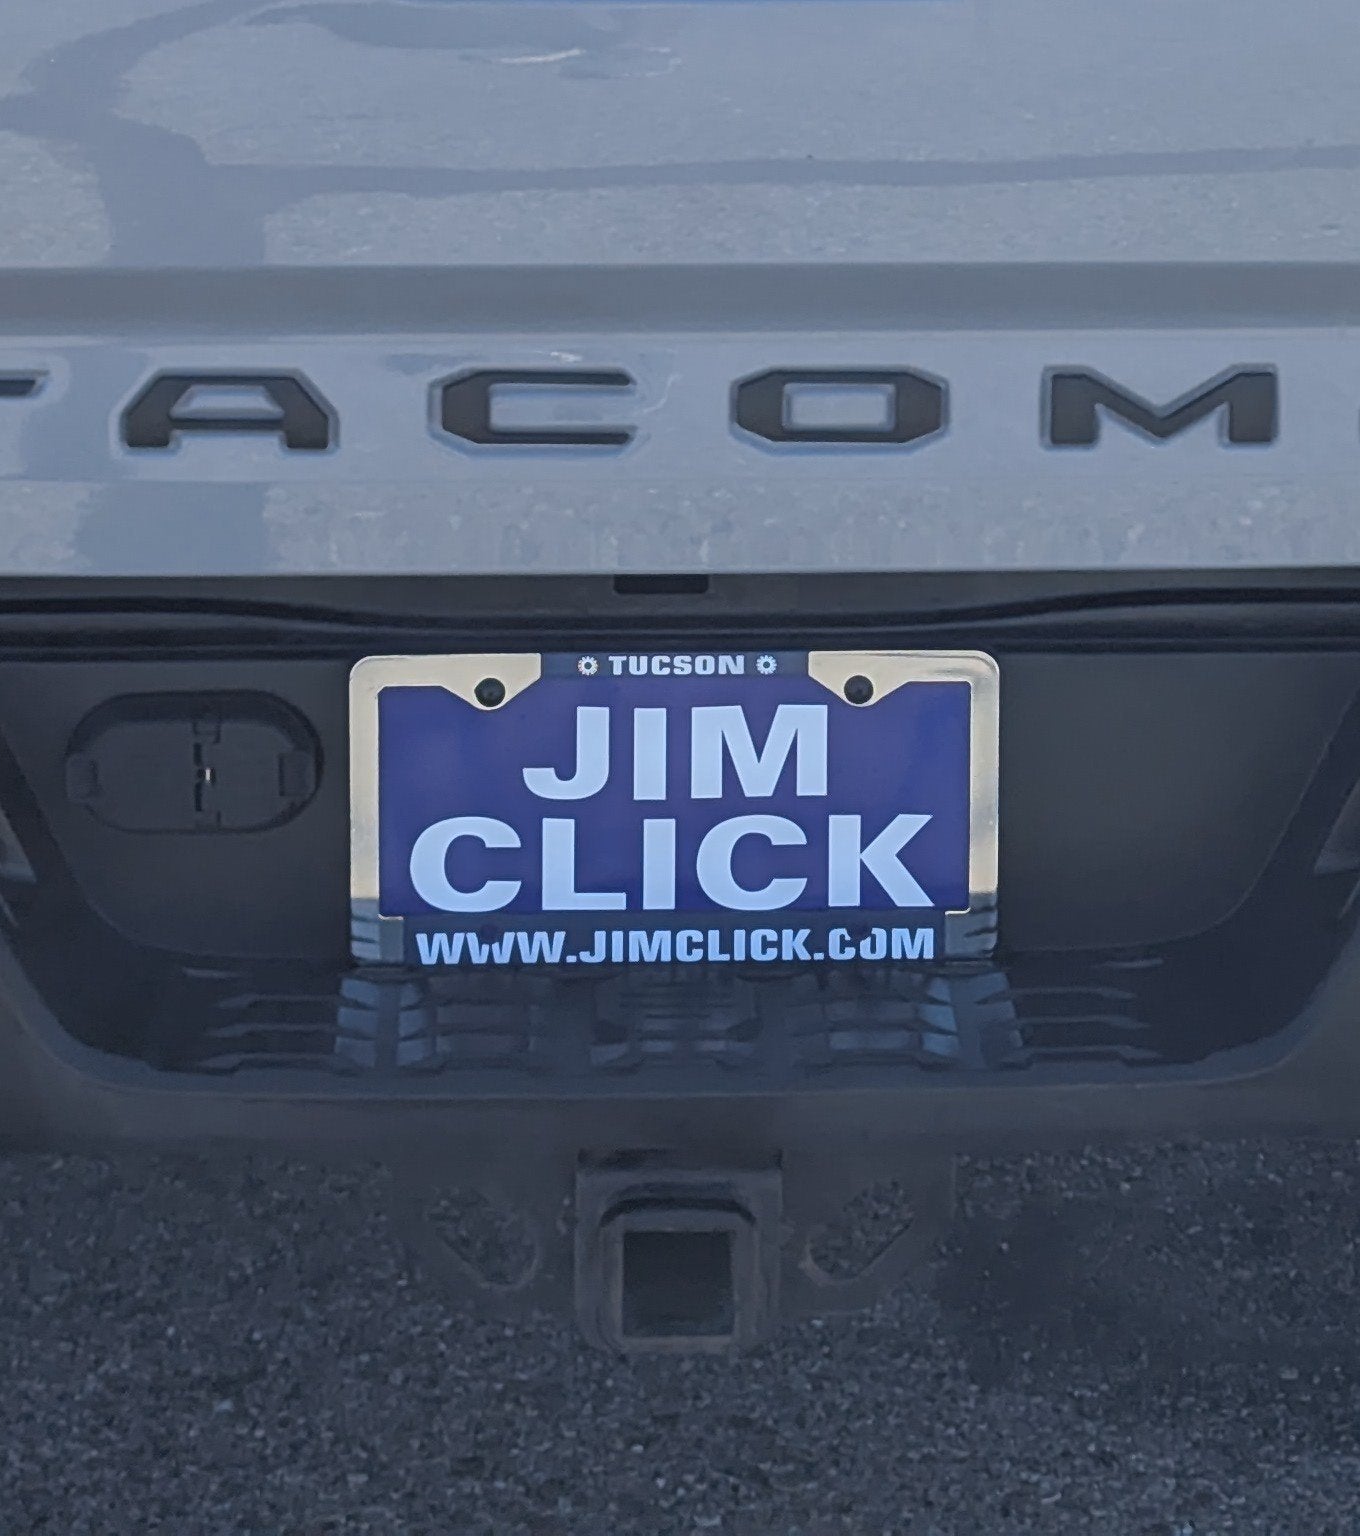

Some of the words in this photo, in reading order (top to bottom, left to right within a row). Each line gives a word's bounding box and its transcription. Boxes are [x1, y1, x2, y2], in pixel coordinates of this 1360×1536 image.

[607, 655, 746, 676] TUCSON
[522, 704, 829, 801] JIM
[408, 813, 936, 914] CLICK
[415, 927, 935, 965] WWW.JIMCLICK.COM
